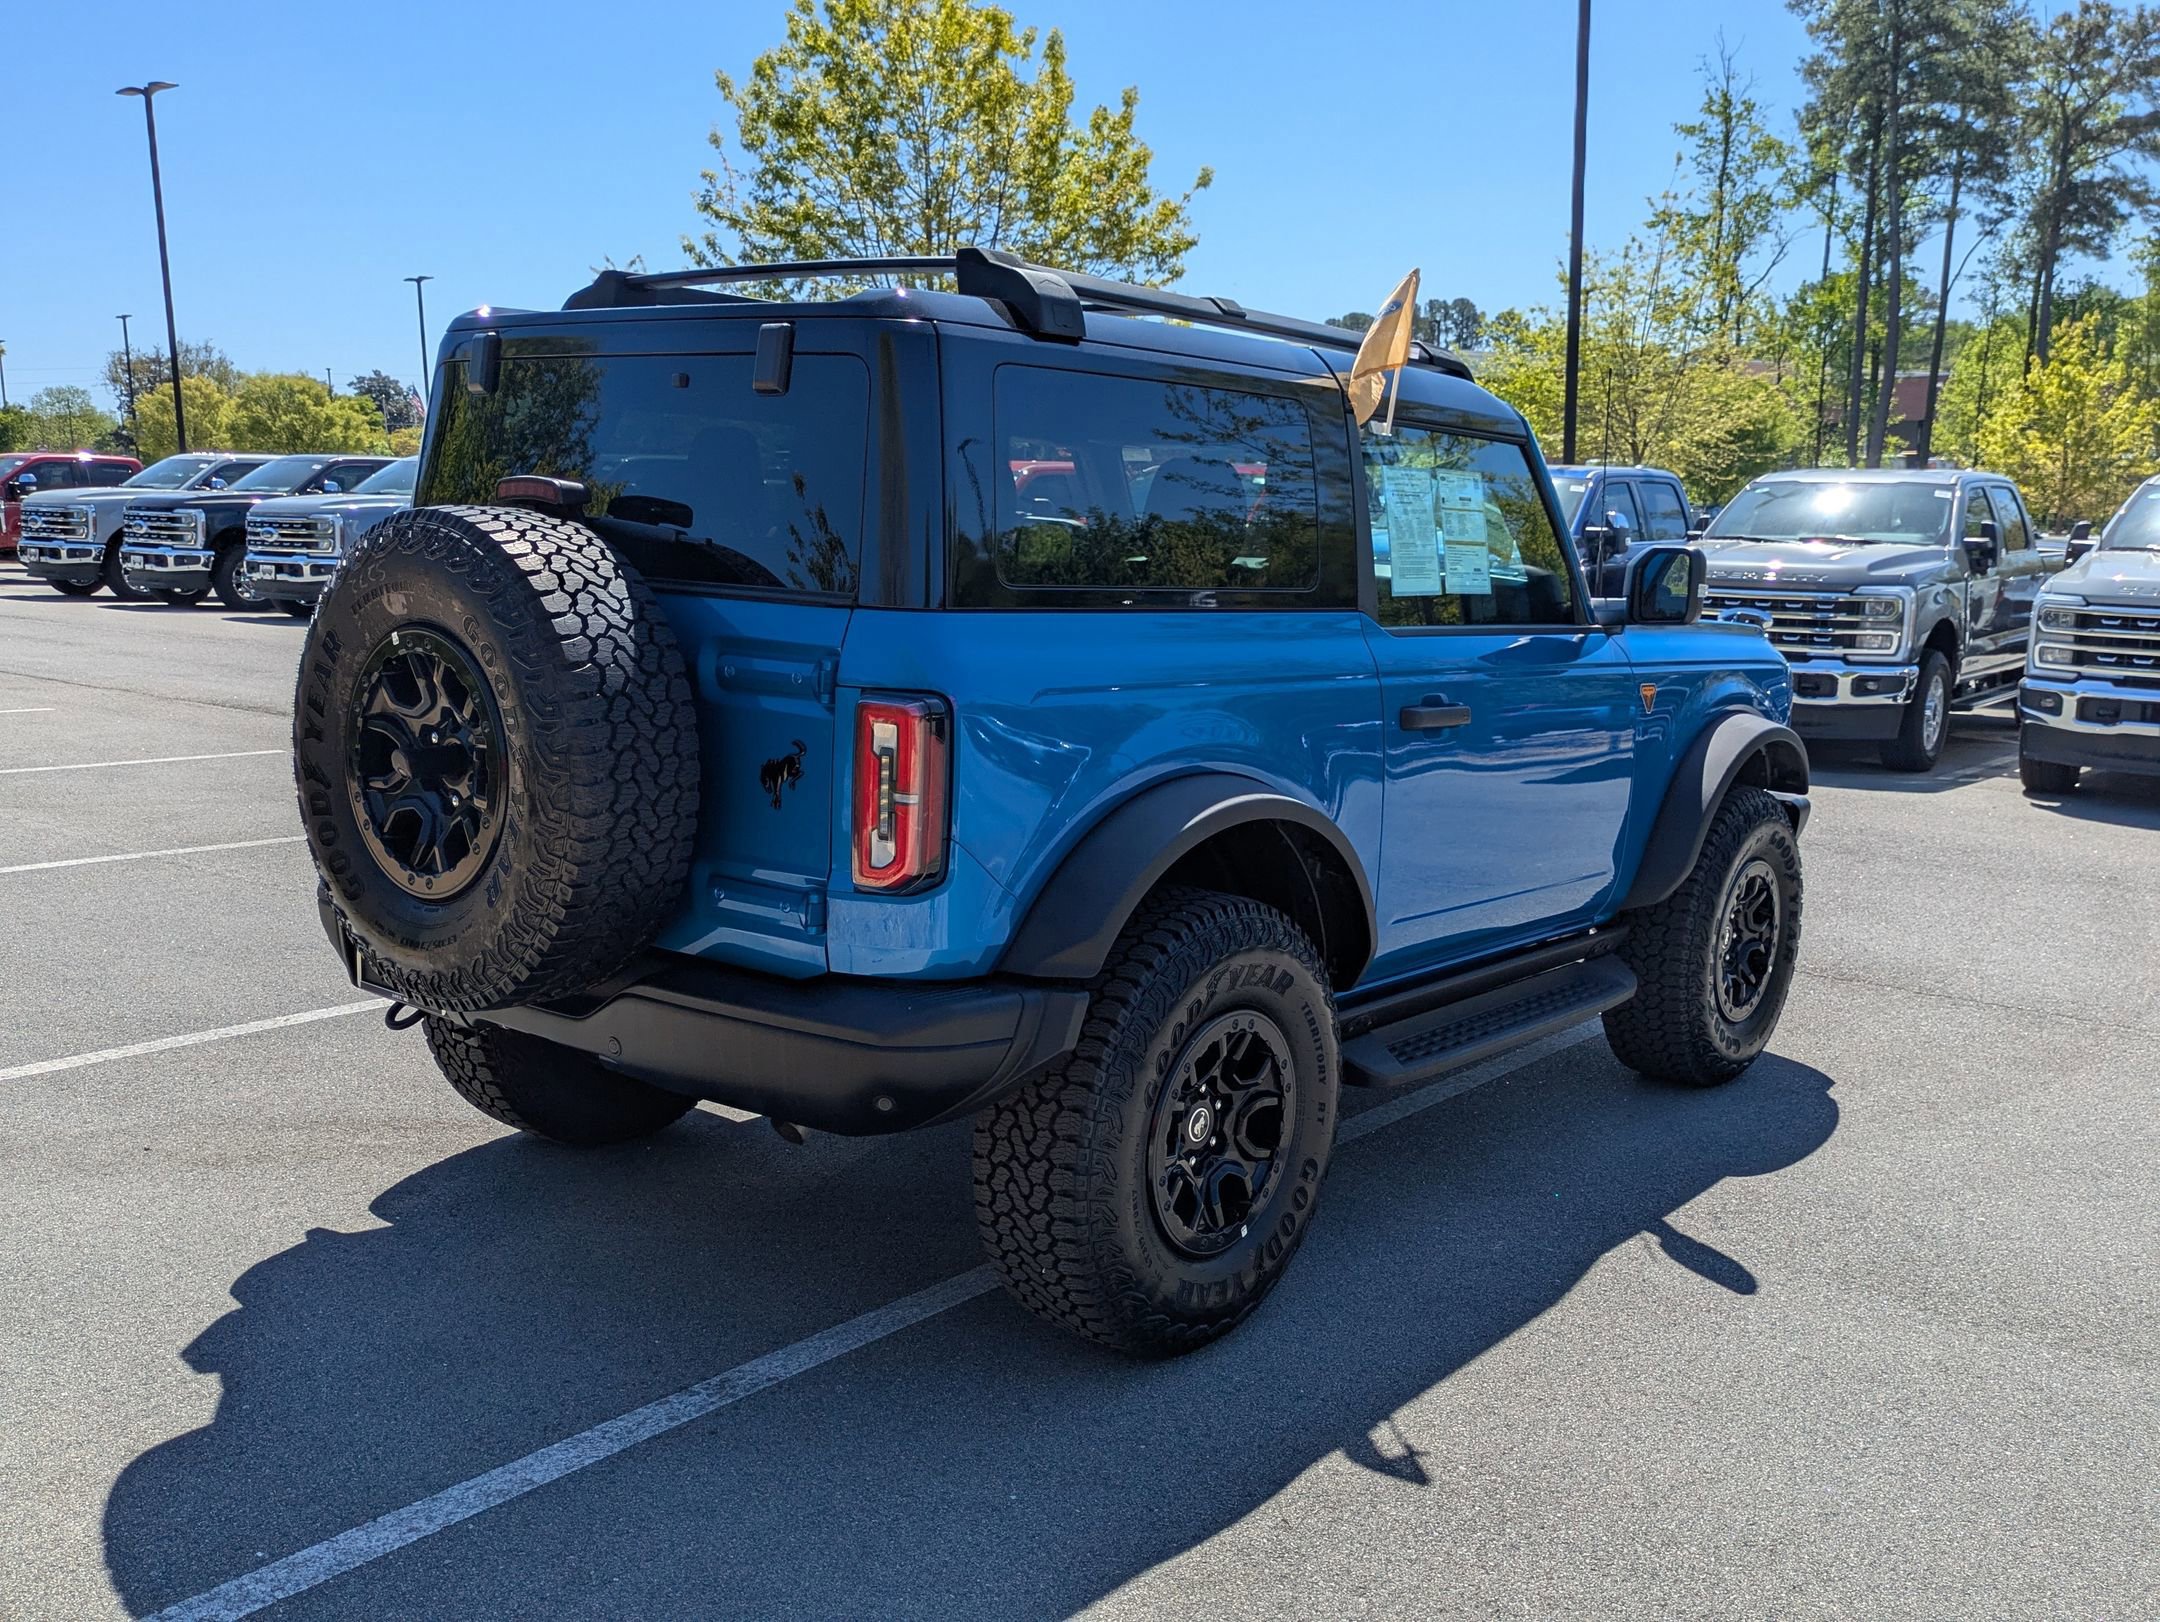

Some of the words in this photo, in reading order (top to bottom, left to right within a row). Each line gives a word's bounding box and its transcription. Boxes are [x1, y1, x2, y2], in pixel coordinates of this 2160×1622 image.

[305, 628, 362, 902] GOODYEAR
[1769, 830, 1801, 964] GOODYEAR
[1145, 962, 1295, 1111] GOODYEAR
[1301, 1001, 1327, 1086] TERRITORY
[1316, 1101, 1327, 1127] RT
[1178, 1157, 1320, 1305] GOODYEAR
